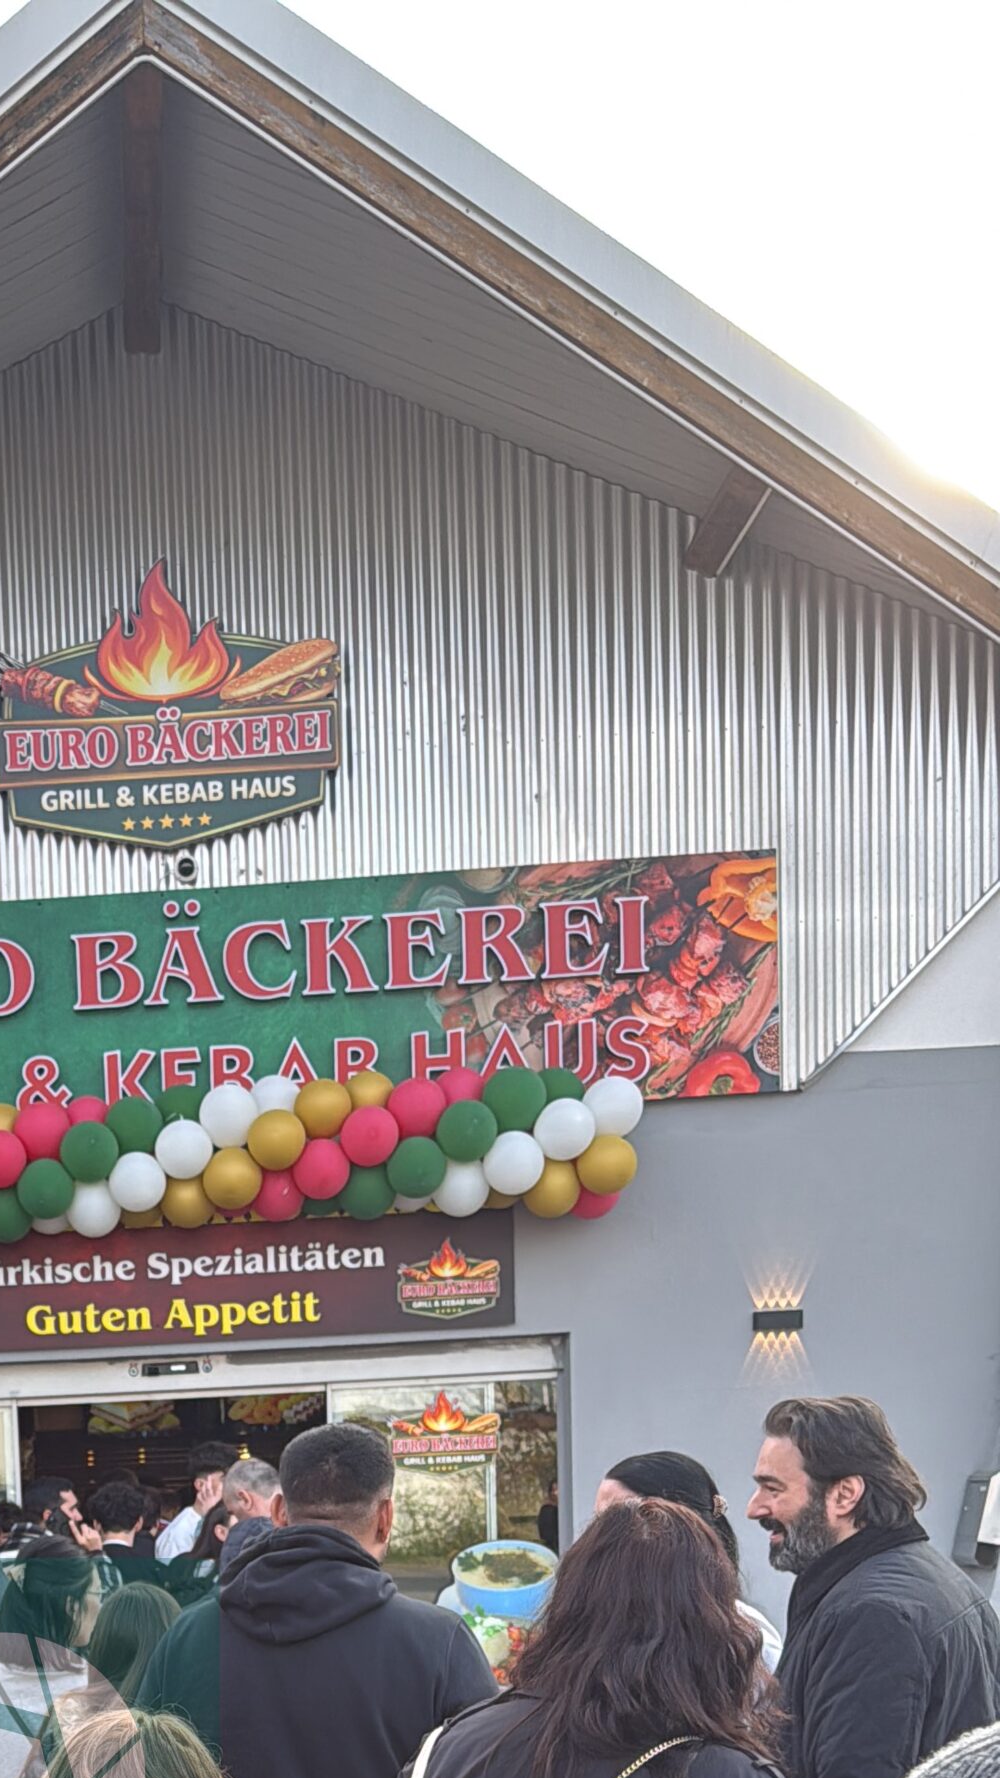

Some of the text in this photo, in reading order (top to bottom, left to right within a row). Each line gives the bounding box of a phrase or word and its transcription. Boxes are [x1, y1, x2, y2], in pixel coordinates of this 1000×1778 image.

[3, 706, 333, 773] EURO BÄCKEREI
[40, 775, 297, 813] GRILL & KEBAB HAUS
[71, 896, 650, 1013] BÄCKEREI
[16, 1055, 73, 1109] &
[410, 1016, 651, 1084] HAUS
[146, 1243, 386, 1286] Spezialitäten
[25, 1290, 322, 1337] Guten Appetit
